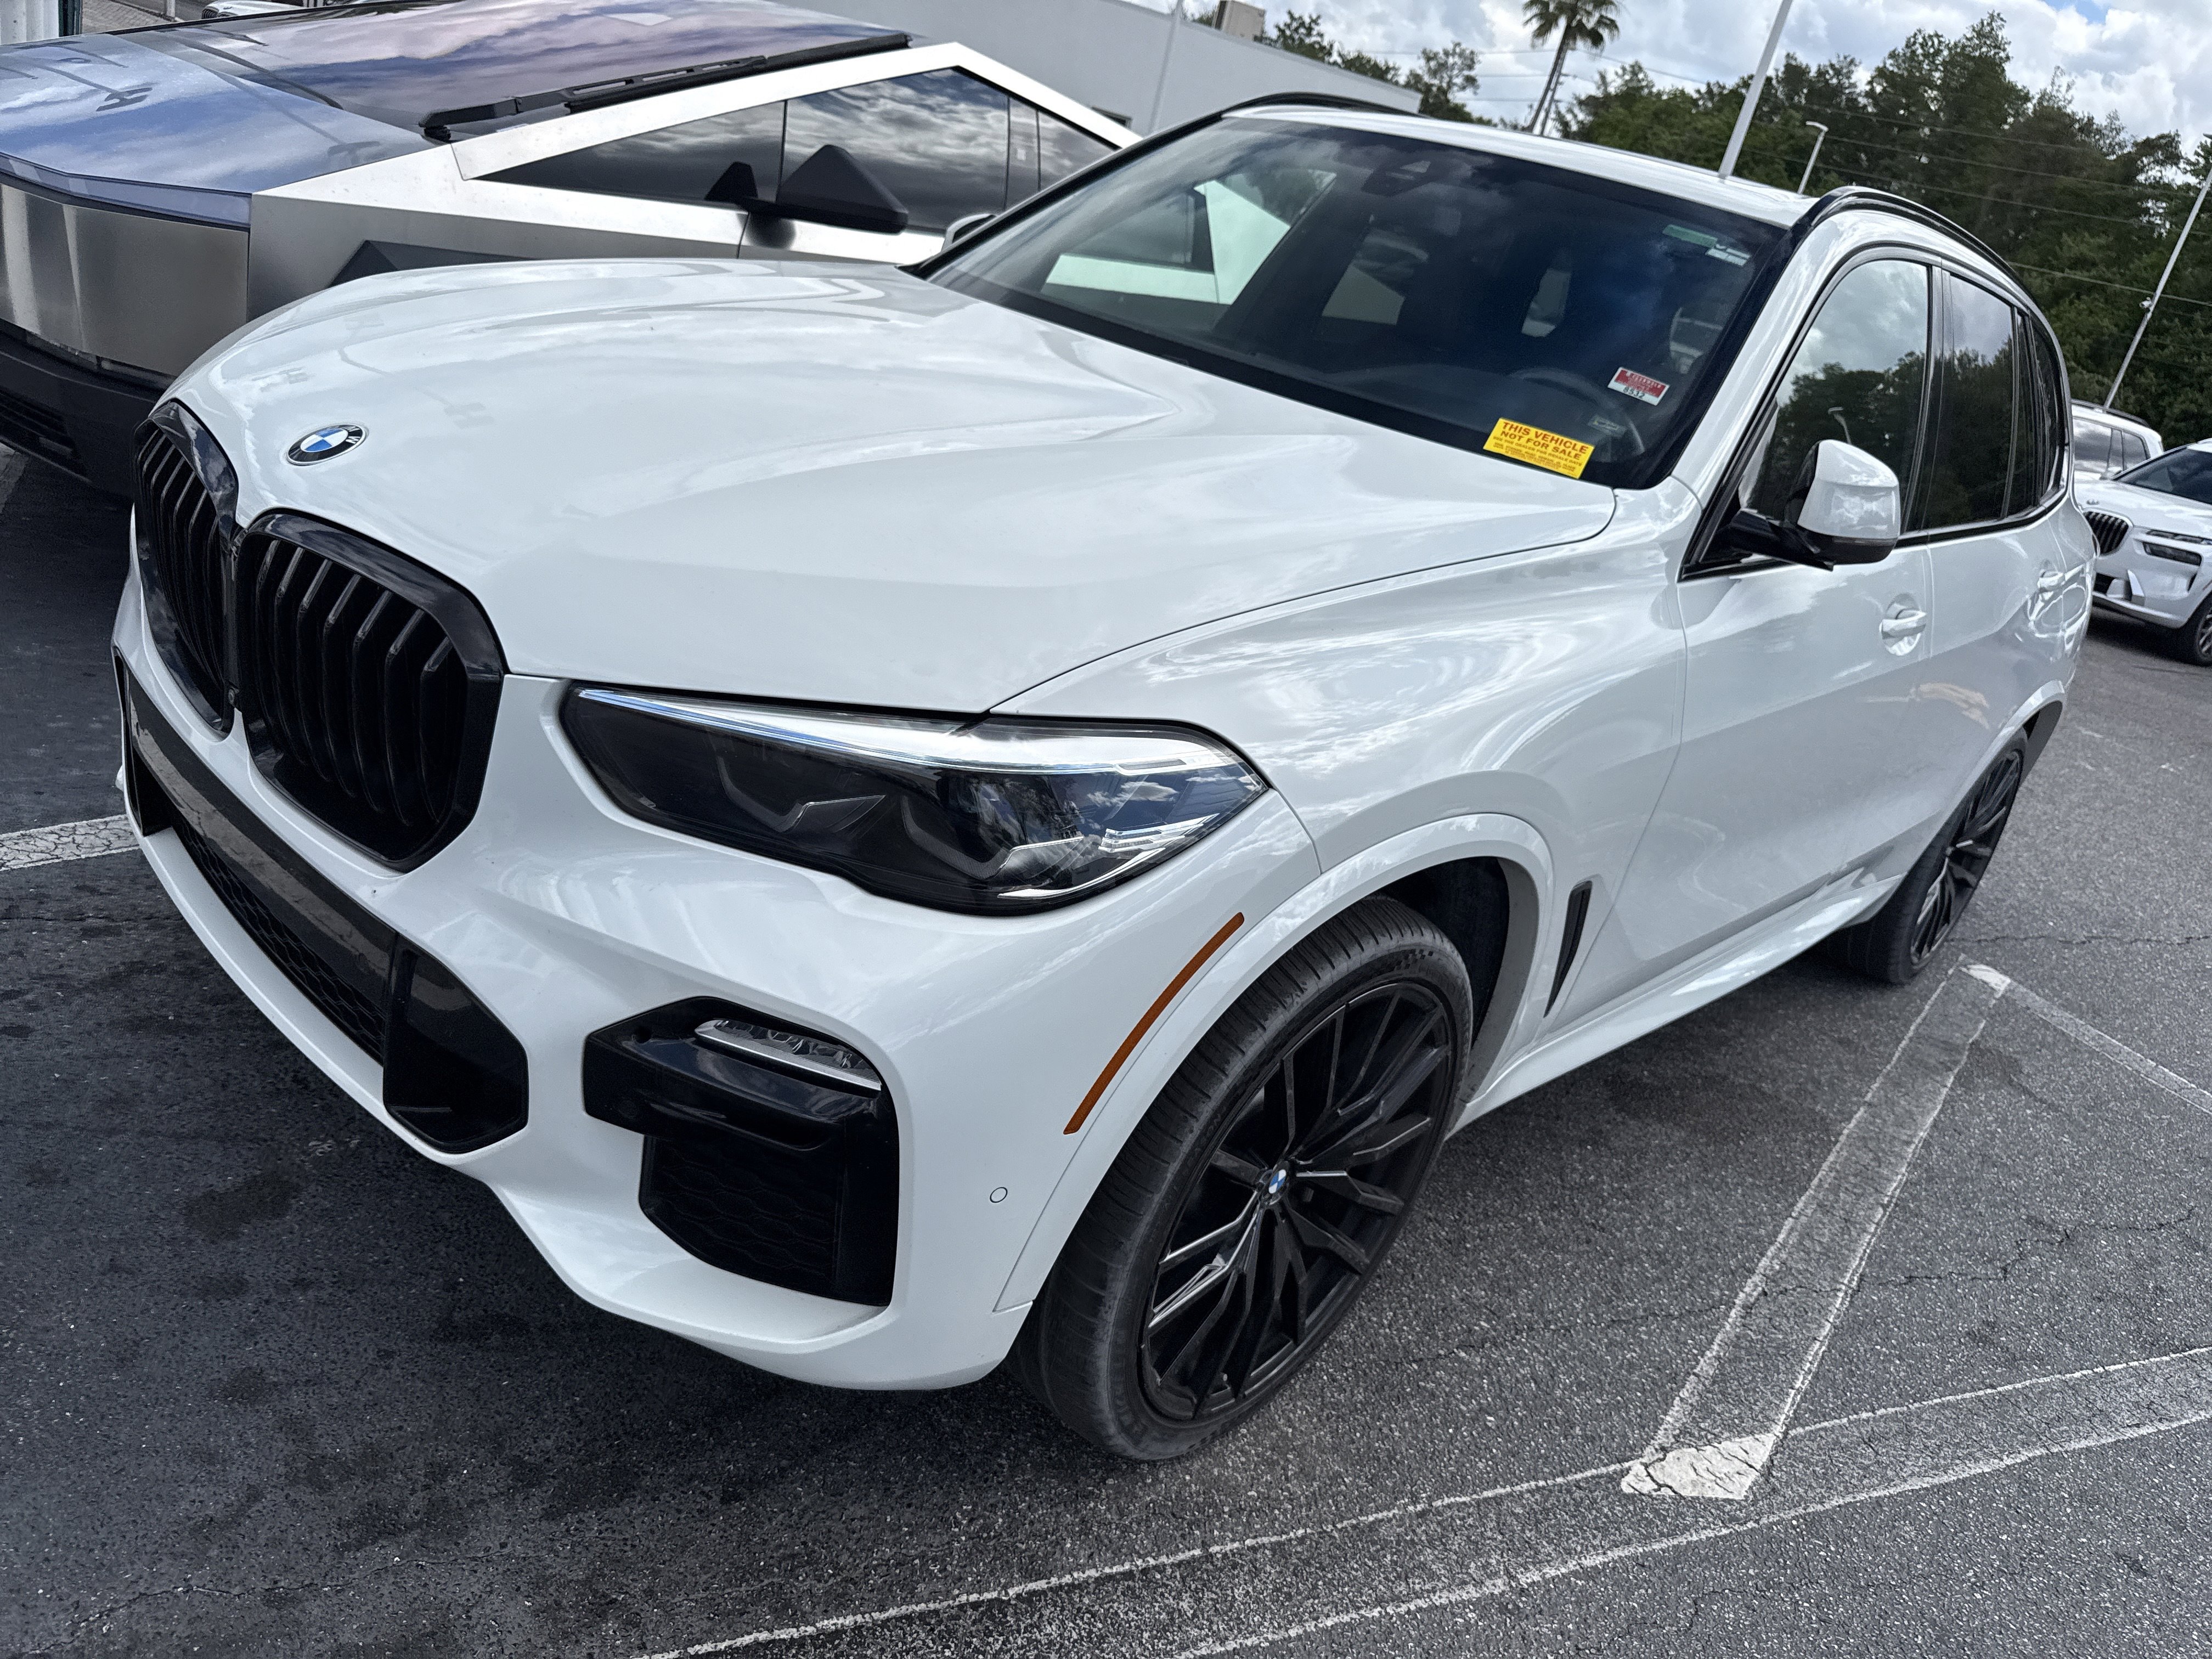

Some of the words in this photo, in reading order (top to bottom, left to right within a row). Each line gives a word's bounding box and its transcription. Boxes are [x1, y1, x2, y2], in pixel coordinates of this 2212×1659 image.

[1500, 431, 1523, 442] NOT
[1526, 438, 1549, 450] FOR
[1552, 447, 1582, 460] SALE
[1503, 422, 1531, 436] THIS
[1535, 431, 1589, 454] VEHICLE
